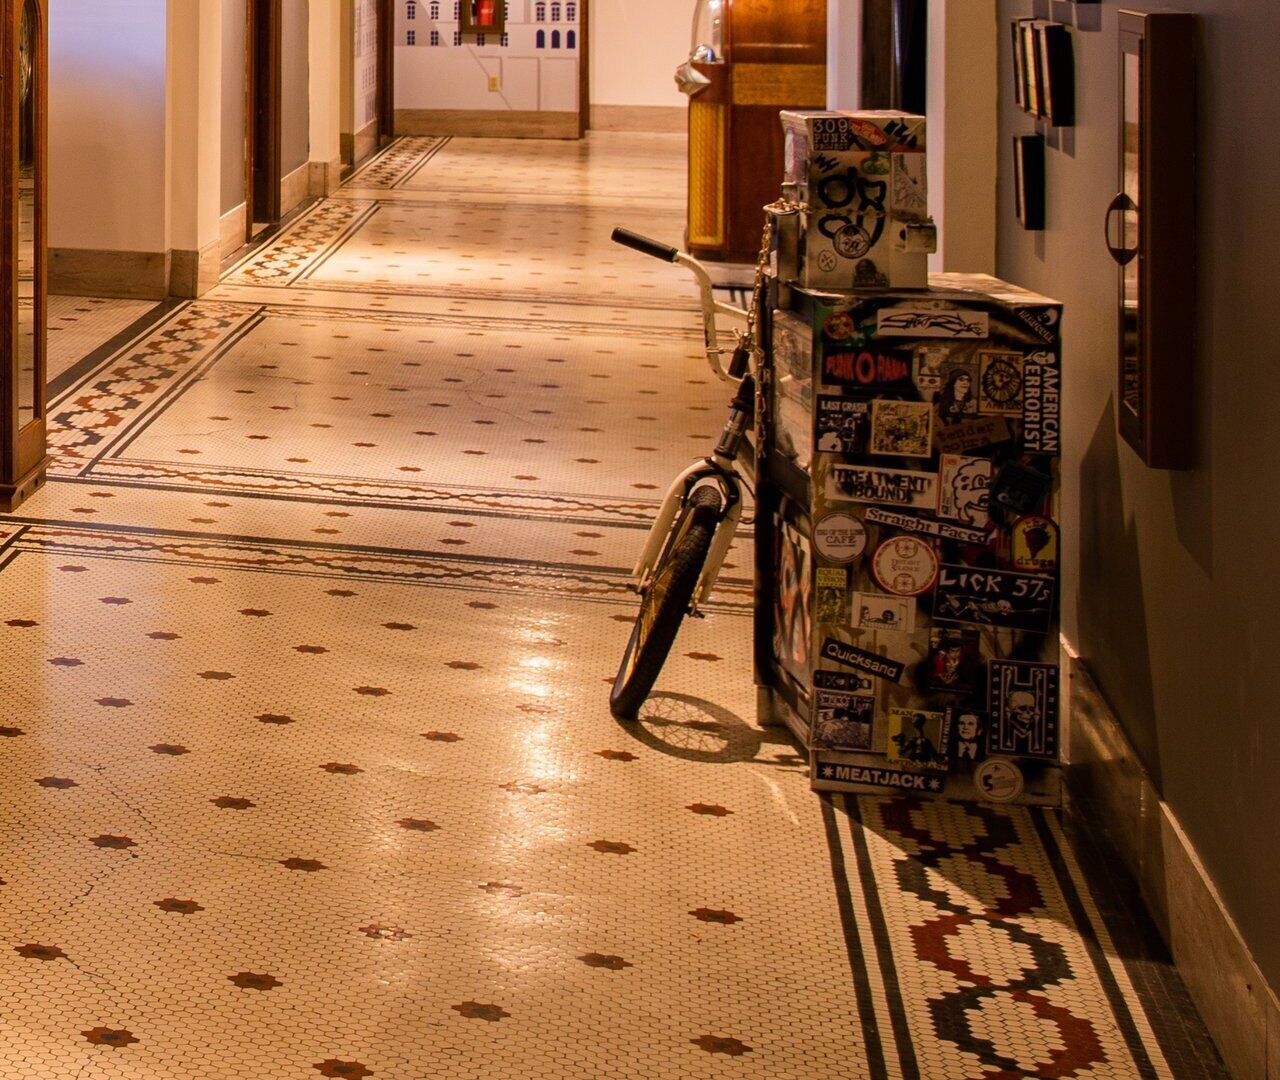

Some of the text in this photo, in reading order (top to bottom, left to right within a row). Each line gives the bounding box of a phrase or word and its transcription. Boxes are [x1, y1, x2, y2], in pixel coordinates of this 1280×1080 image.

[813, 119, 849, 133] 309
[814, 134, 848, 142] PUNK
[821, 401, 841, 411] LAST
[1042, 366, 1059, 452] AMERICAN
[831, 467, 928, 493] TREATMENT
[867, 507, 990, 545] Straight Faced
[940, 569, 1003, 594] LICK
[826, 642, 898, 678] Quicksand
[836, 766, 927, 790] MEATJACK
